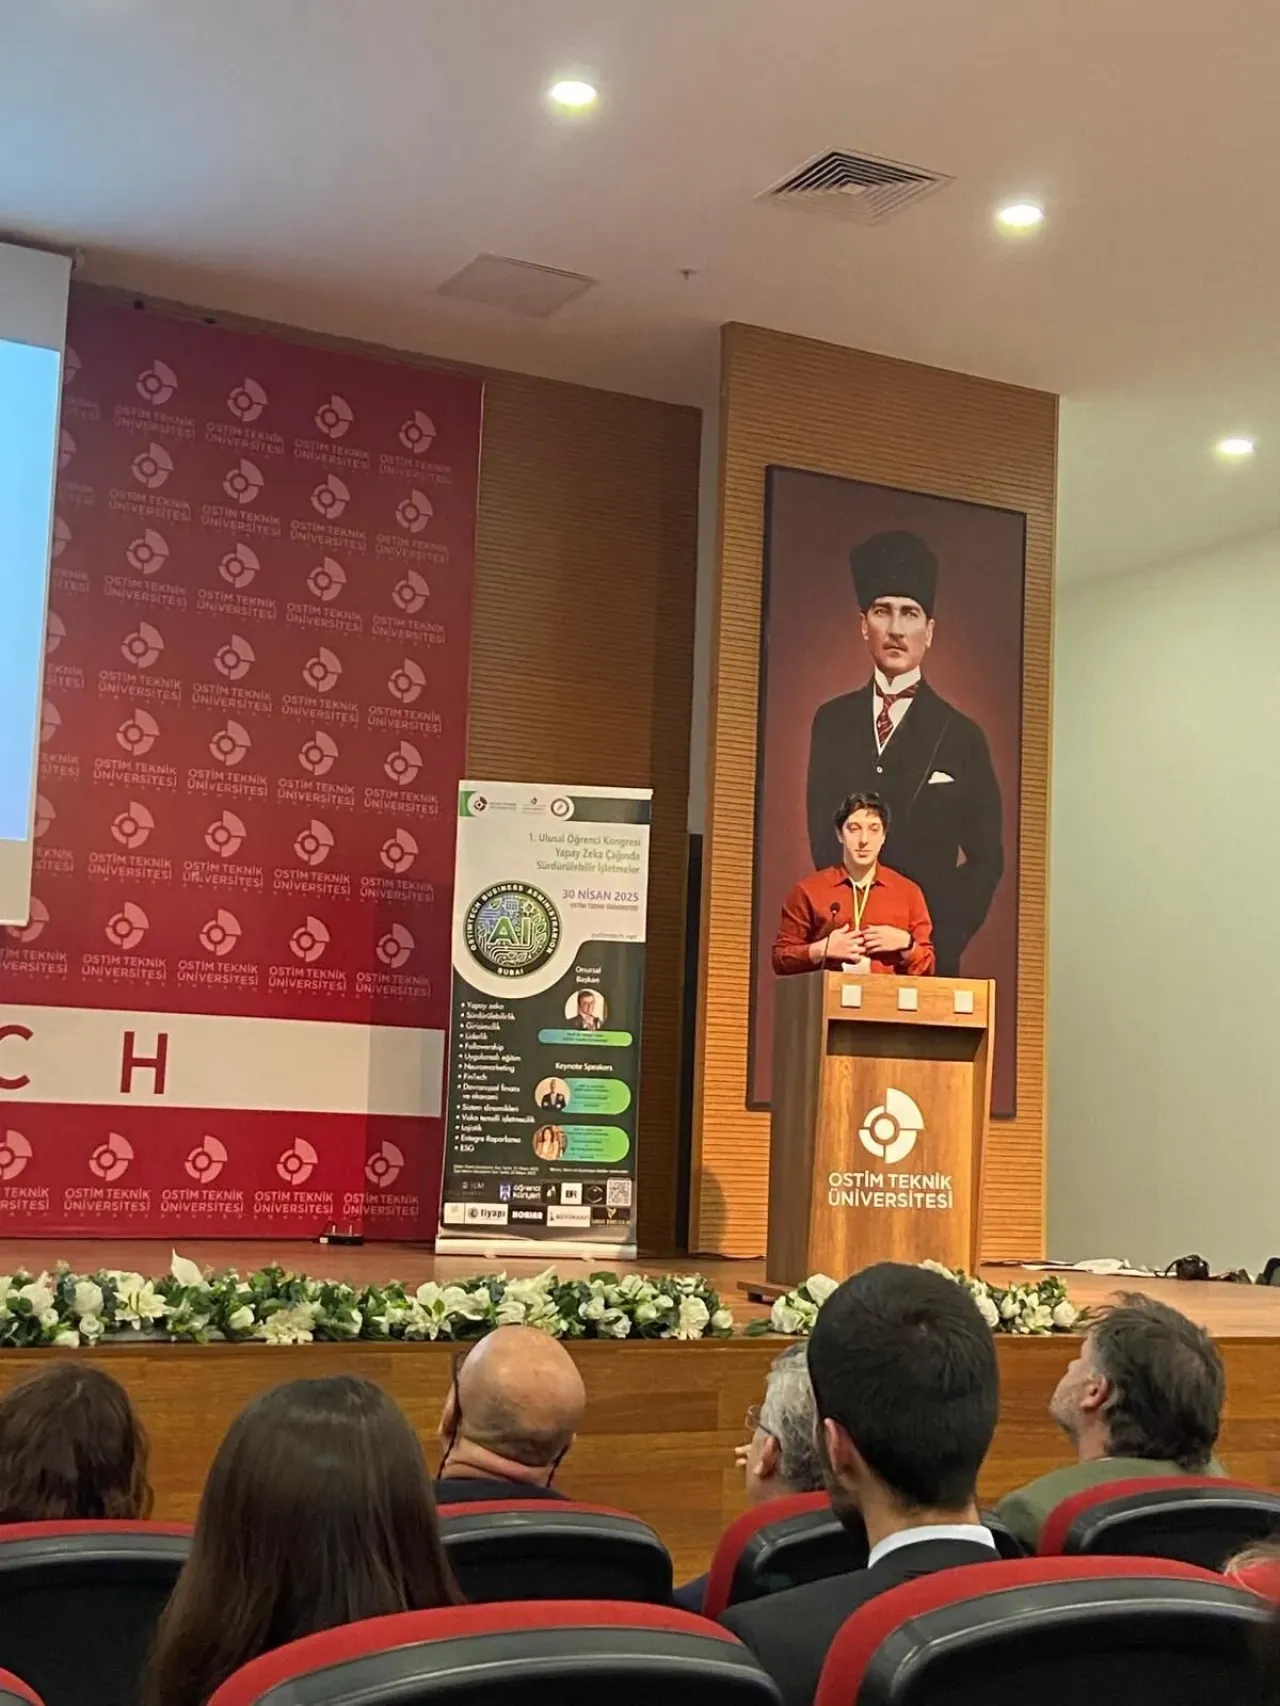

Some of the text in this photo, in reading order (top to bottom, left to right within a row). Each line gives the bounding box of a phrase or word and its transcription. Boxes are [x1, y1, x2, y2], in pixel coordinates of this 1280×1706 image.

[134, 761, 177, 775] TEKNİK
[226, 772, 267, 786] TEKNİK
[315, 781, 354, 794] TEKNİK
[400, 791, 438, 804] TEKNİK
[539, 833, 565, 843] Ulusal
[567, 834, 600, 846] Öğrenci
[603, 836, 641, 847] Kongresi
[555, 847, 580, 859] Yapay
[605, 850, 640, 861] Çağında
[128, 855, 172, 868] TEKNİK
[536, 861, 595, 871] Sürdürülebilir
[221, 863, 263, 876] TEKNİK
[310, 870, 350, 883] TEKNİK
[562, 889, 639, 902] 30 NİSAN 2025
[488, 916, 531, 946] AI
[123, 956, 166, 968] TEKNİK
[216, 961, 258, 974] TEKNİK
[306, 968, 346, 980] TEKNİK
[466, 1001, 487, 1010] Yapay
[555, 1061, 613, 1072] Keynote Speakers
[828, 1170, 952, 1190] OSTİM TEKNİK
[4, 1186, 49, 1198] TEKNİK
[108, 1187, 152, 1198] TEKNİK
[202, 1189, 245, 1200] TEKNİK
[293, 1191, 334, 1201] TEKNİK
[381, 1193, 420, 1203] TEKNİK
[828, 1187, 953, 1208] ÜNİVERSİTESİ
